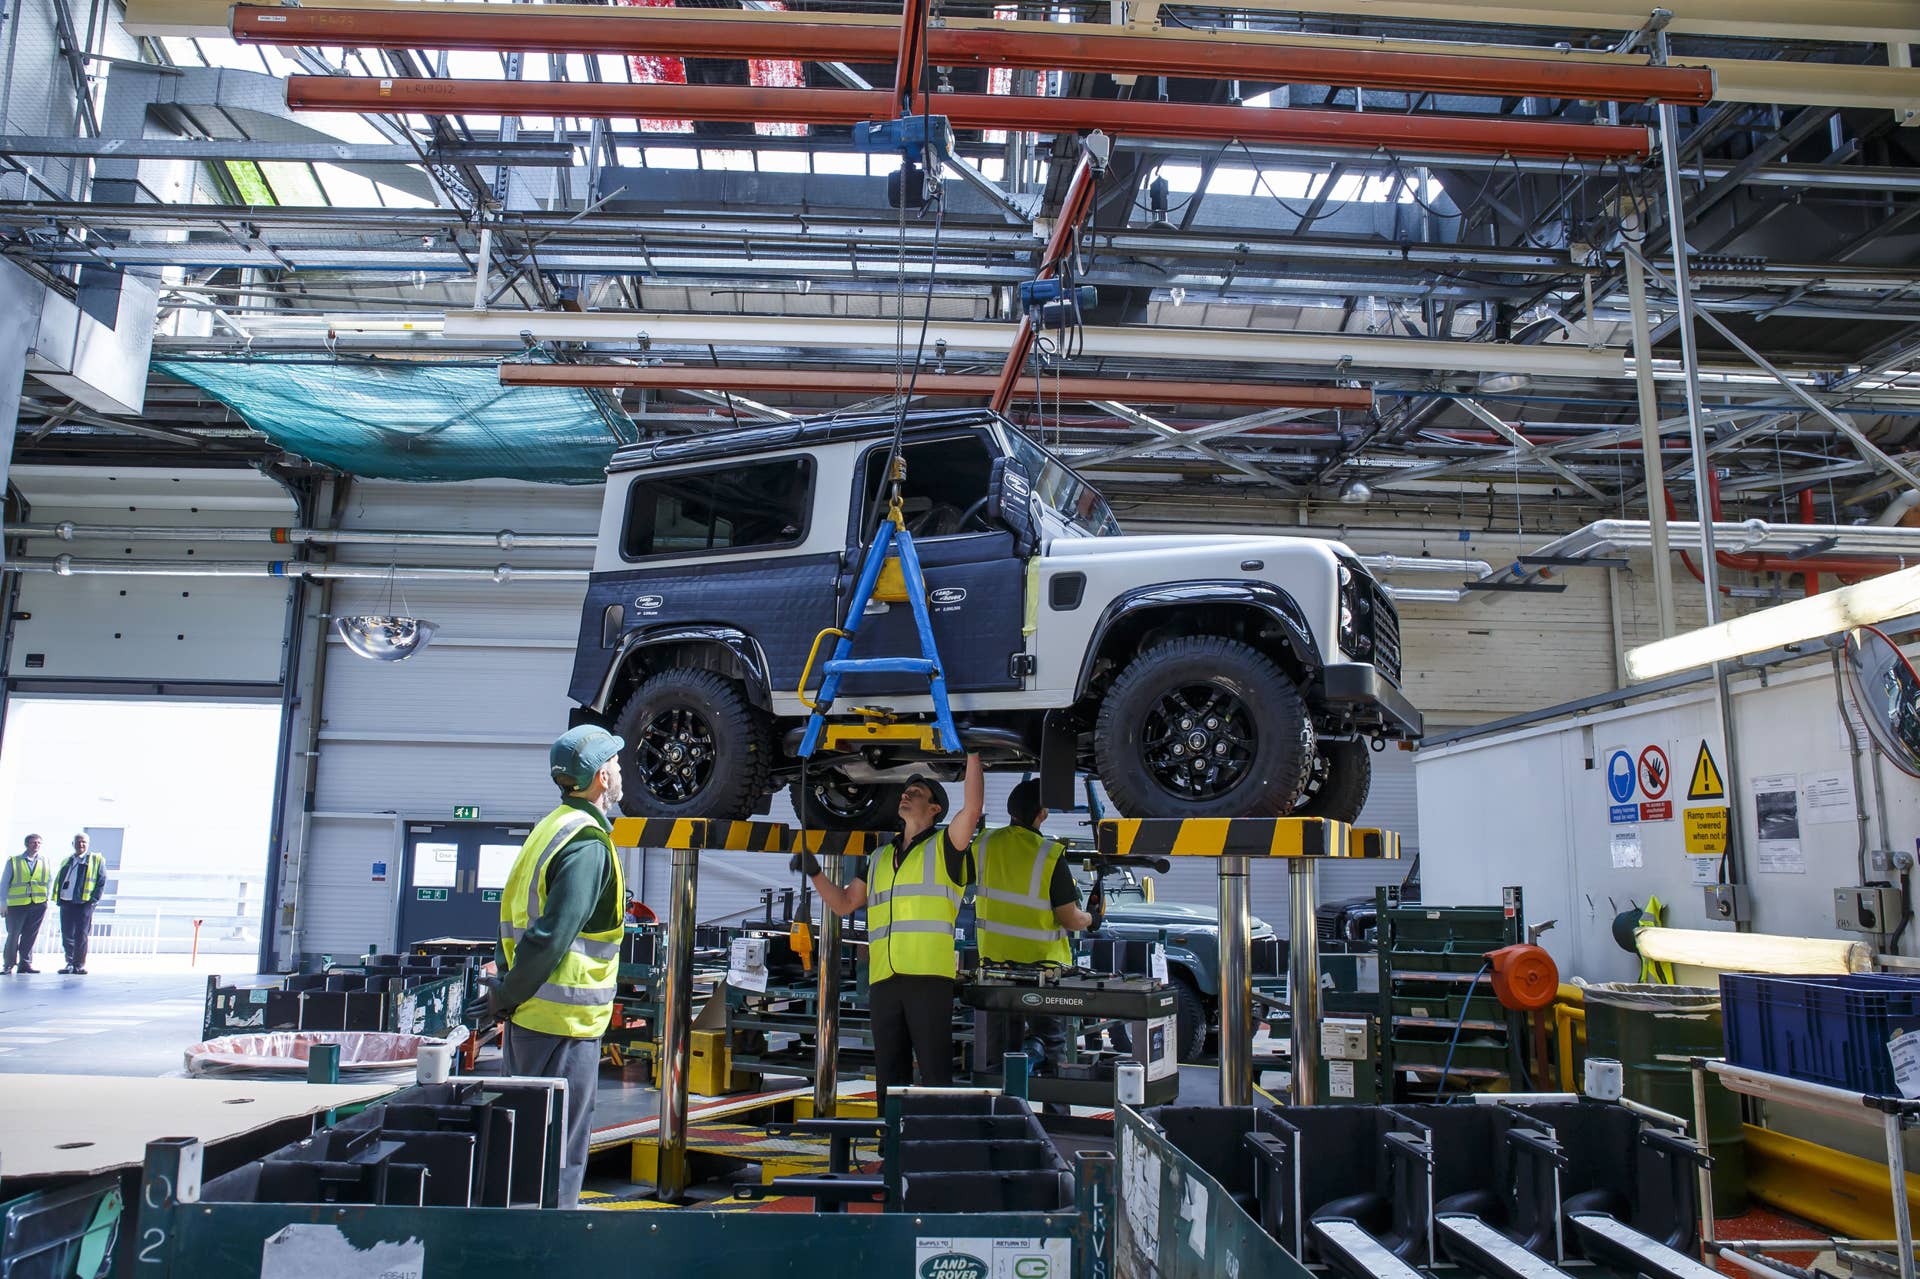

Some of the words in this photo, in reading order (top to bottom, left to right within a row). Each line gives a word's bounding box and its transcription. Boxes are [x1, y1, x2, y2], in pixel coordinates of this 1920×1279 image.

[1687, 811, 1705, 820] Ramp
[1706, 811, 1721, 819] must
[1697, 821, 1722, 829] lowered
[1692, 831, 1709, 840] when
[1710, 832, 1720, 840] not
[1045, 996, 1083, 1006] DEFENDER
[932, 1258, 968, 1270] LAND
[937, 1270, 978, 1279] ROVER
